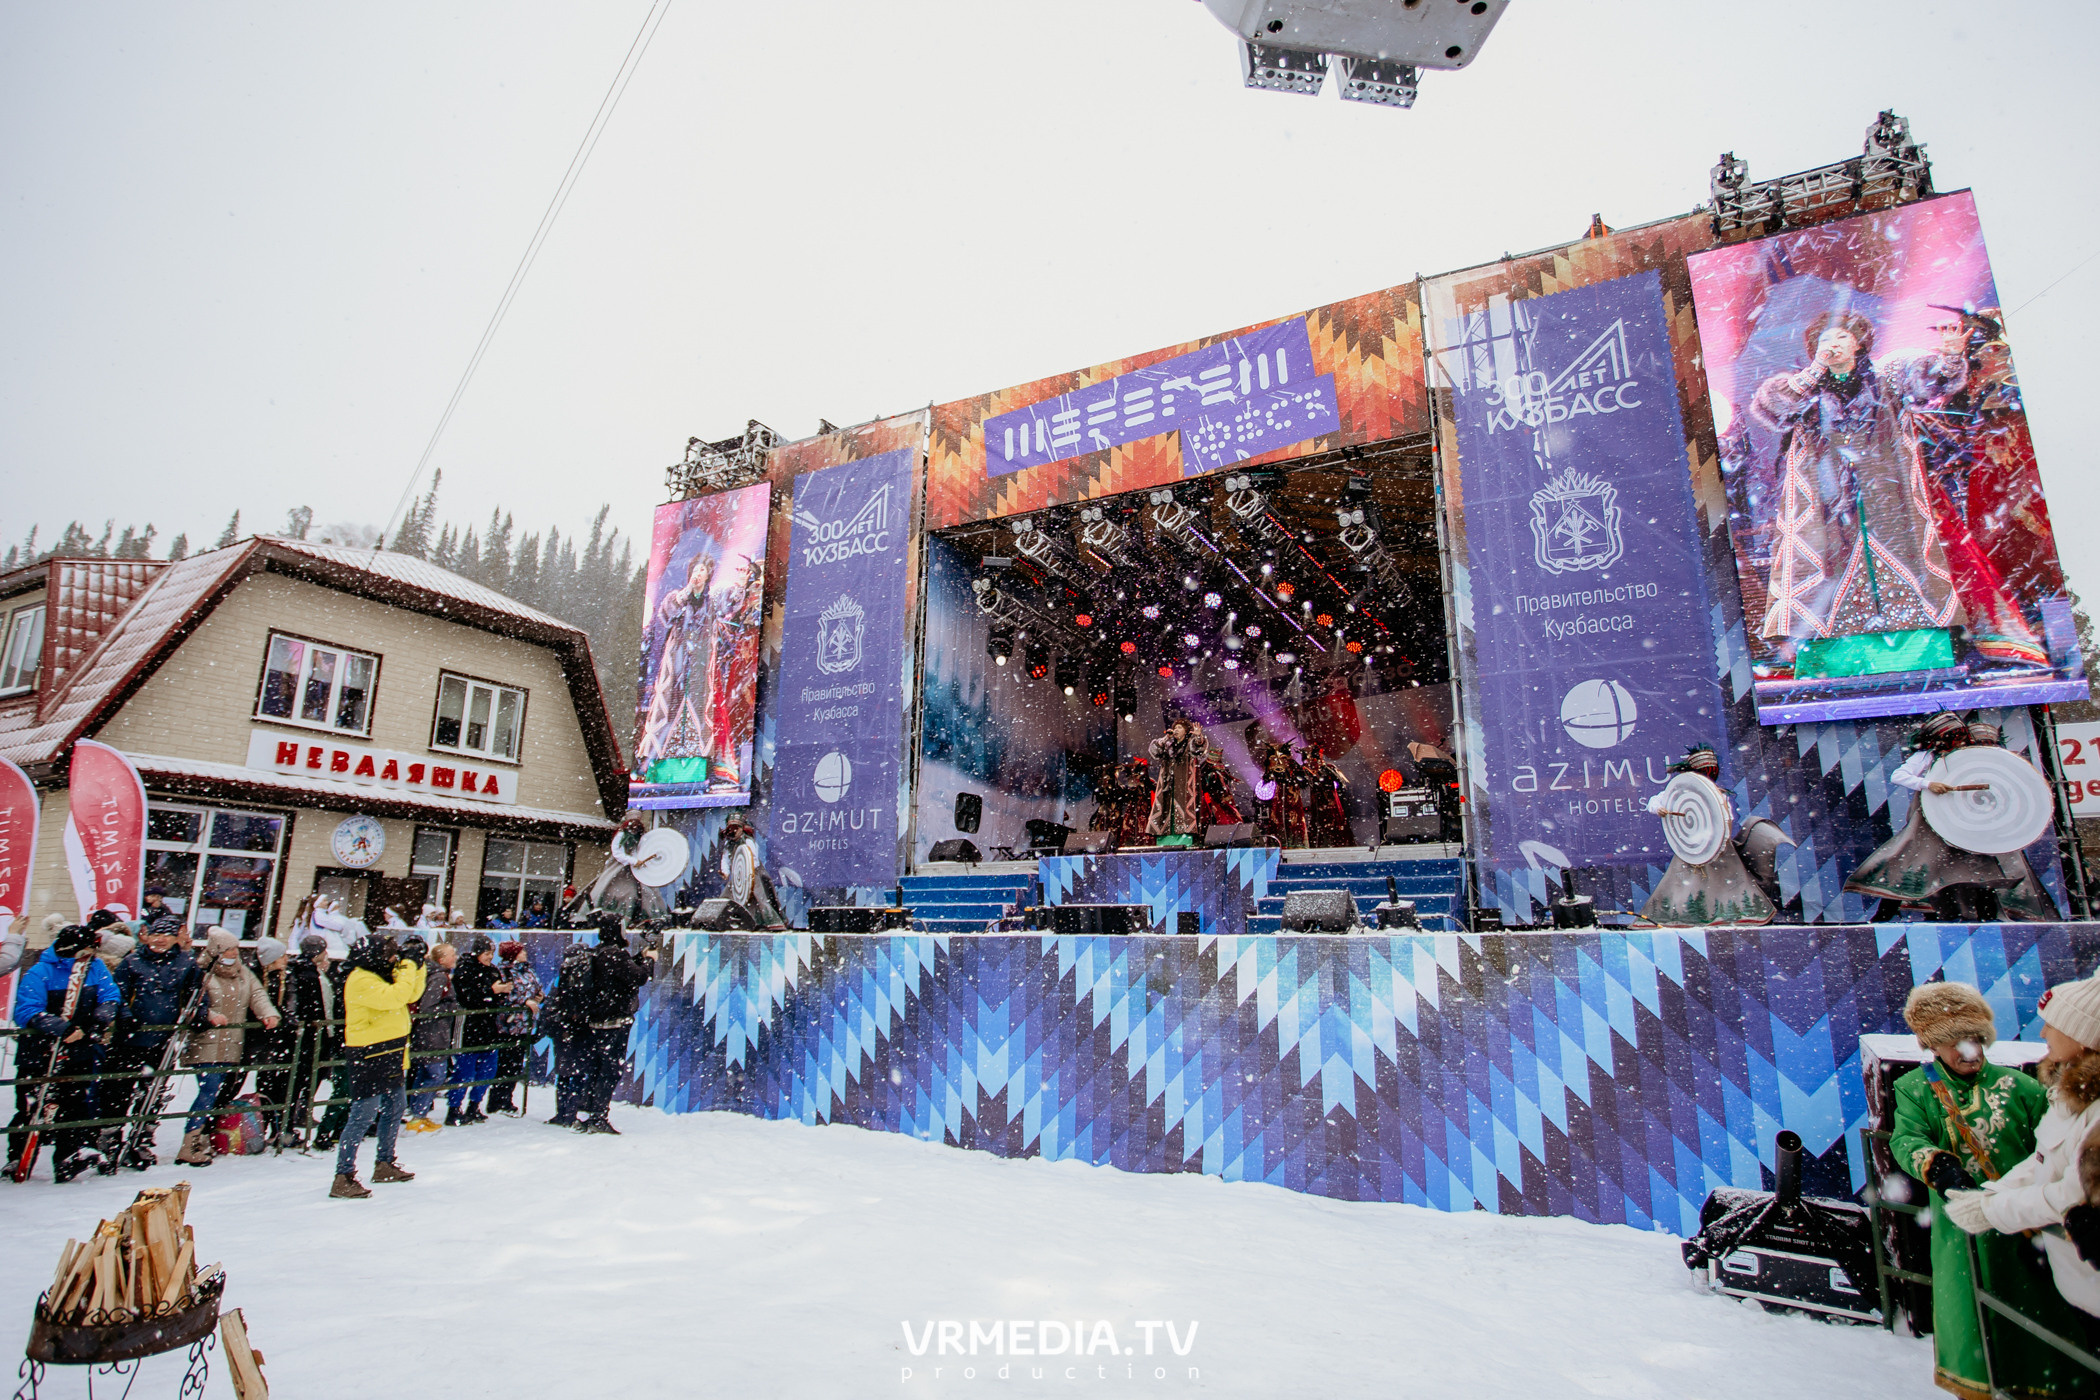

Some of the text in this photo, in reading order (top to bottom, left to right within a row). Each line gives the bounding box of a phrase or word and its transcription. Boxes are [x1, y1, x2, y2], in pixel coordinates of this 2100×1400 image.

[1486, 381, 1642, 435] КУЗБАСС
[808, 520, 843, 545] 300
[804, 531, 889, 567] КУЗБАСС
[1516, 582, 1658, 616] Правительство
[1544, 614, 1633, 641] Кузбасса
[801, 682, 876, 704] Правительство
[812, 705, 859, 724] Кузбасса
[275, 741, 500, 796] НЕВАЛЯШКА
[1569, 797, 1648, 815] HOTELS
[809, 838, 849, 851] HOTELS
